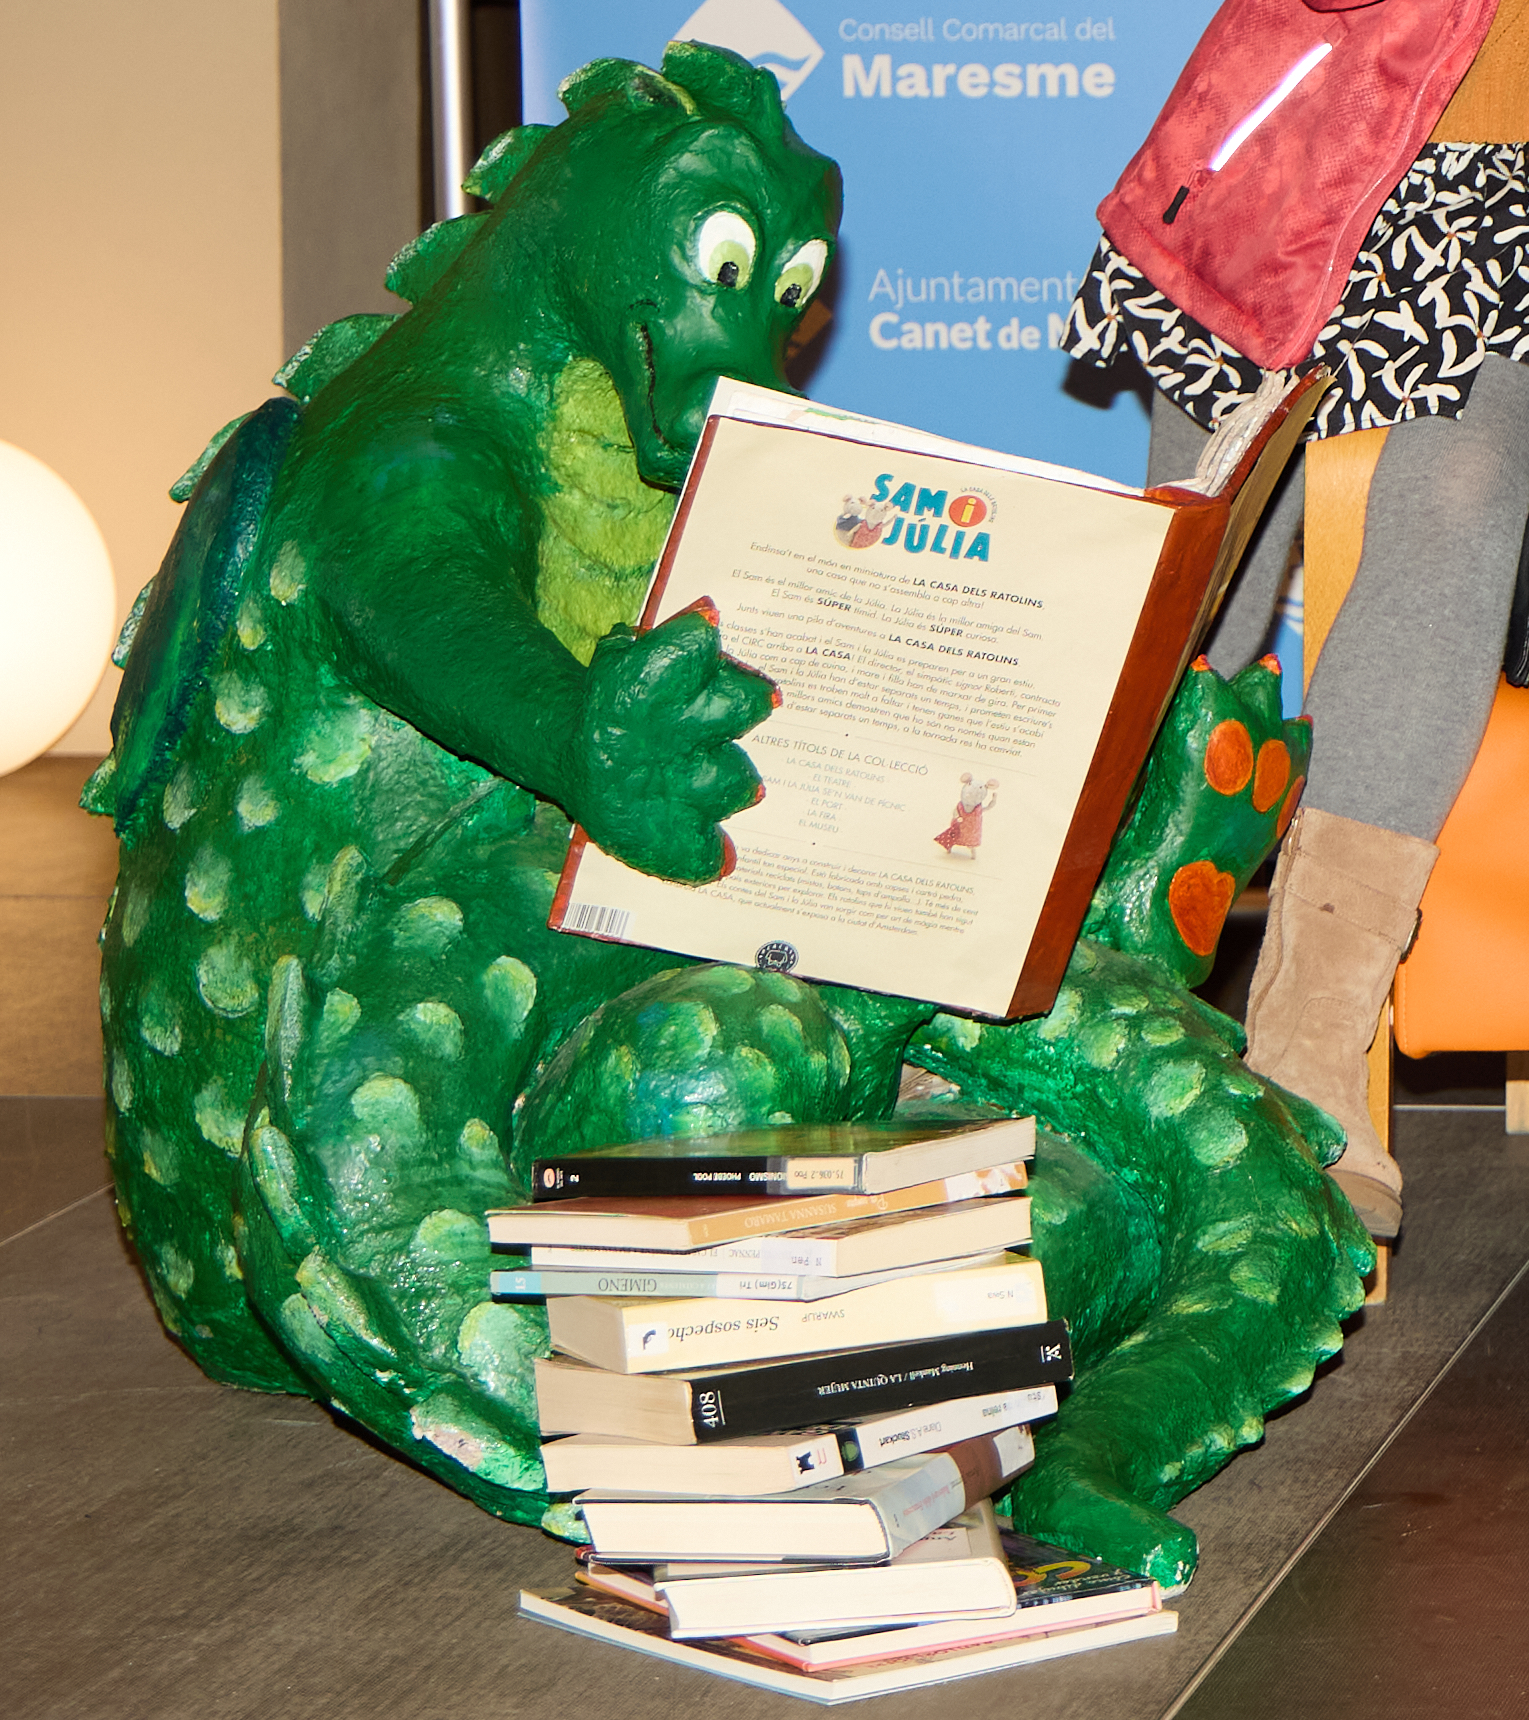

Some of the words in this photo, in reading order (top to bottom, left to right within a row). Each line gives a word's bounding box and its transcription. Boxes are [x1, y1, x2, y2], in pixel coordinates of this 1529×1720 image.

[838, 16, 936, 43] Consell
[942, 16, 1069, 42] Comarcal
[1074, 16, 1117, 42] del
[842, 53, 1116, 98] Maresme
[868, 268, 1077, 310] Ajuntament
[869, 311, 993, 351] Canet
[998, 316, 1042, 351] de
[869, 473, 949, 518] SAM
[881, 516, 991, 562] JÚLIA
[899, 574, 911, 585] de
[913, 577, 926, 588] LA
[930, 580, 958, 593] CASA
[962, 585, 987, 598] DELS
[816, 596, 851, 612] SÚPER
[929, 623, 963, 638] SÚPER
[805, 646, 818, 656] LA
[888, 633, 901, 644] LA
[905, 637, 934, 651] CASA
[938, 644, 963, 657] DELS
[751, 734, 790, 749] ALTRES
[793, 739, 827, 755] TÍTOLS
[830, 747, 844, 759] DE
[847, 751, 860, 762] LA
[744, 1210, 789, 1229] TAMARO
[789, 1202, 837, 1222] SUSANNA
[597, 1277, 658, 1293] GIMENO
[745, 1314, 780, 1333] Seis
[801, 1308, 845, 1324] SWARUP
[816, 1381, 851, 1397] MUJER
[850, 1374, 889, 1390] QUINTA
[888, 1373, 903, 1385] LA
[699, 1390, 719, 1428] 408
